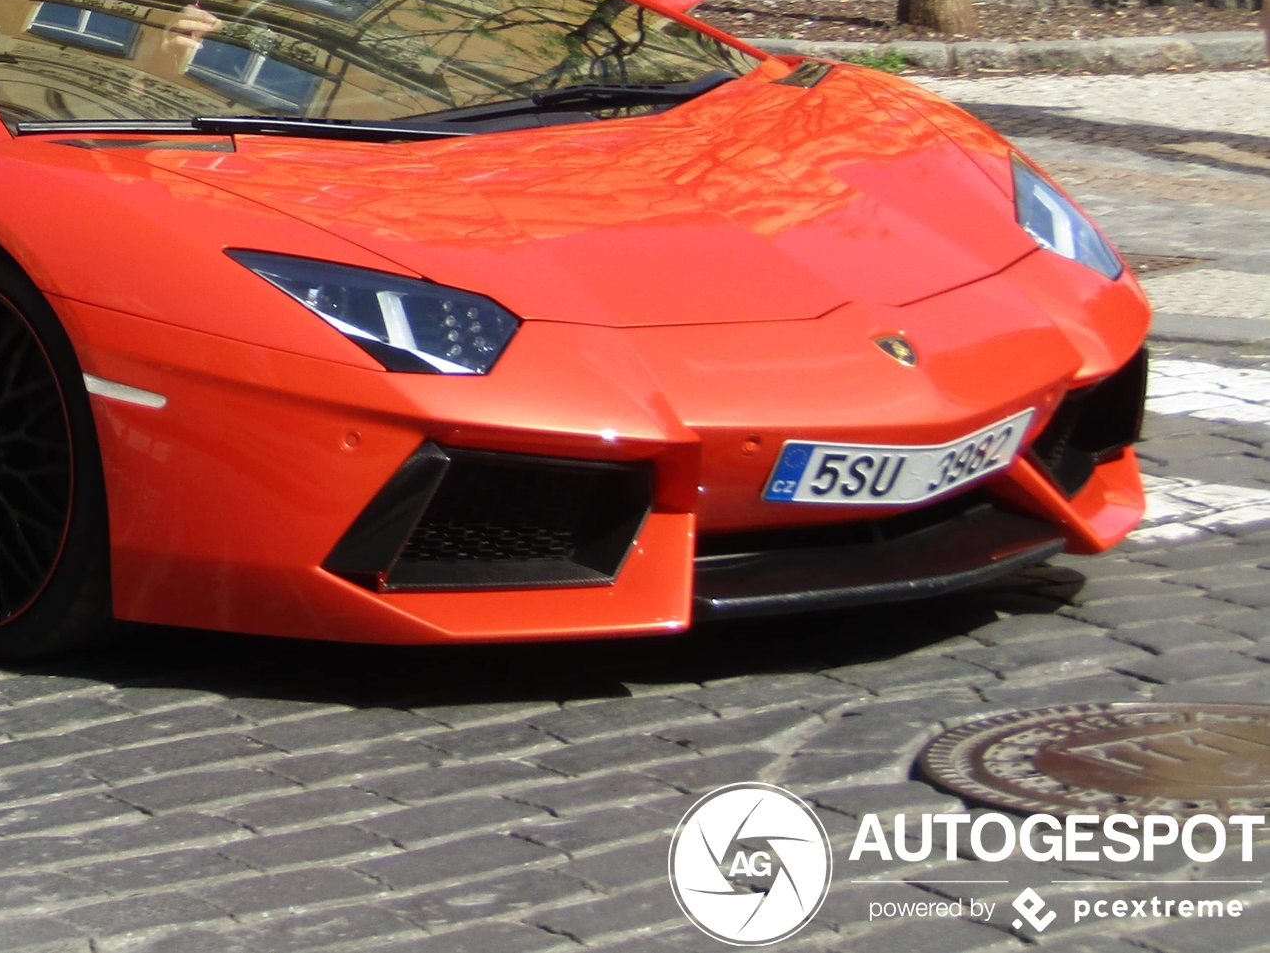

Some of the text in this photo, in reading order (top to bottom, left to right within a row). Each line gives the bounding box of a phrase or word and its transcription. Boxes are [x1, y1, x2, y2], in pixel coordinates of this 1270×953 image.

[809, 424, 1014, 498] 5SU 3982
[771, 479, 795, 494] CZ
